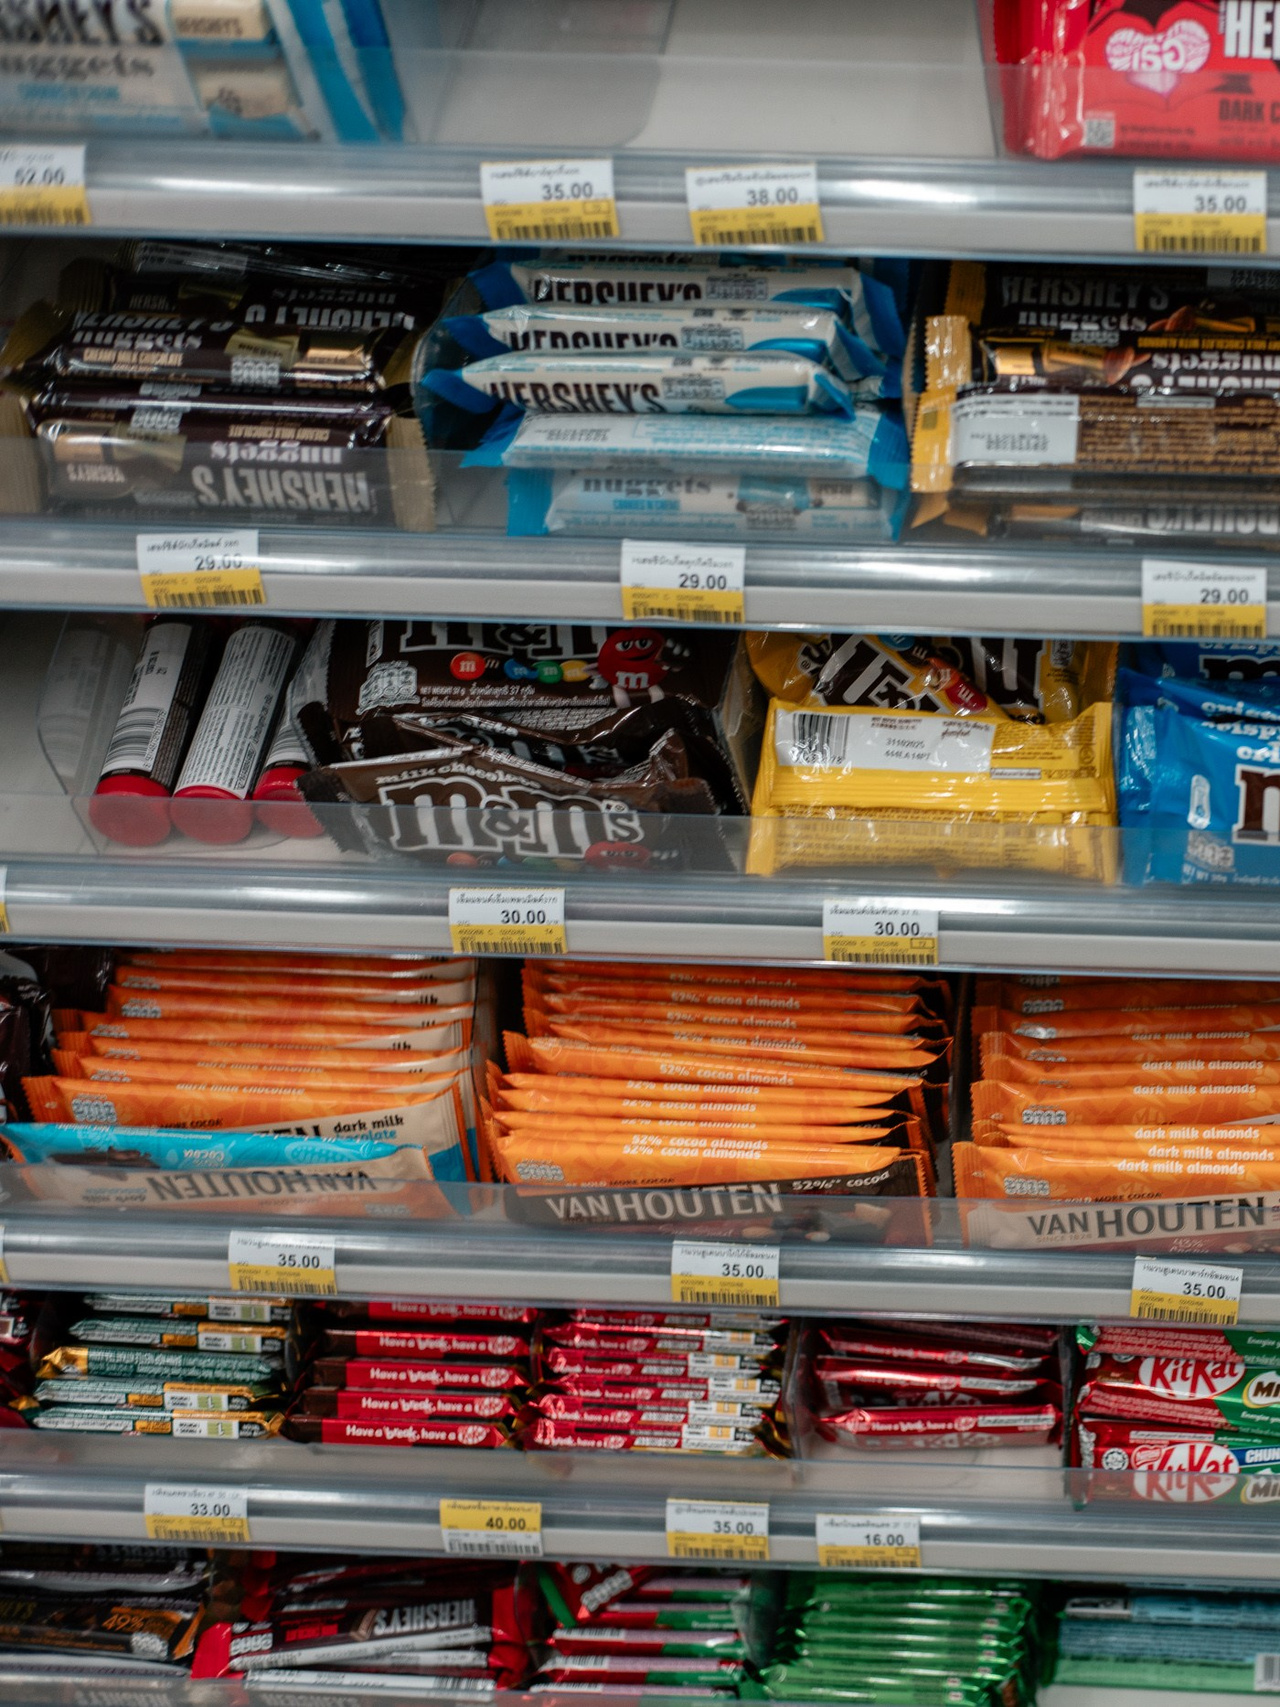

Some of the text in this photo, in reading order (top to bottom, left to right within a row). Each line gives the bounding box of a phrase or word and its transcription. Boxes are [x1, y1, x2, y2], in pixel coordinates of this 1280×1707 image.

[1219, 99, 1264, 124] DARK
[541, 181, 594, 201] 35.00
[746, 187, 799, 208] 38.00
[1194, 196, 1247, 214] 35.00
[1018, 309, 1148, 334] nuggets
[211, 440, 342, 466] nuggets
[191, 464, 372, 513] HERSHEY'S
[579, 473, 712, 499] nuggets
[194, 554, 243, 571] 29.00
[679, 573, 728, 591] 29.00
[1199, 588, 1249, 604] 29.00
[379, 776, 646, 859] m&m's
[501, 909, 546, 925] 30.00
[874, 921, 920, 936] 30.00
[1141, 1059, 1264, 1071] dark milk almonds
[697, 1069, 735, 1081] cocoa
[737, 1071, 795, 1087] almonds
[1133, 1083, 1256, 1096] dark milk almonds
[334, 1114, 404, 1133] dark milk
[1134, 1126, 1260, 1141] dark milk almonds
[670, 1137, 708, 1149] cocoa
[709, 1137, 769, 1152] almonds
[661, 1147, 698, 1159] cocoa
[700, 1148, 762, 1161] almonds
[1147, 1145, 1275, 1163] dark milk almonds
[1118, 1159, 1245, 1176] dark milk almonds
[846, 1172, 891, 1188] cocoa
[546, 1182, 783, 1222] VAN HOUTEN
[1027, 1195, 1266, 1239] VAN HOUTEN
[278, 1253, 320, 1269] 35.00
[722, 1263, 765, 1279] 35.00
[1183, 1281, 1226, 1299] 35.00
[1152, 1357, 1239, 1397] KitKat
[361, 1397, 389, 1409] Have
[436, 1400, 463, 1412] have
[345, 1425, 374, 1437] Have
[420, 1429, 447, 1440] have
[1149, 1444, 1235, 1501] KitKat
[190, 1503, 231, 1517] 33.00
[485, 1517, 526, 1530] 40.00
[713, 1520, 754, 1534] 35.00
[864, 1533, 905, 1547] 16.00
[102, 1611, 145, 1632] 49%
[373, 1599, 476, 1636] HERSHEY'S
